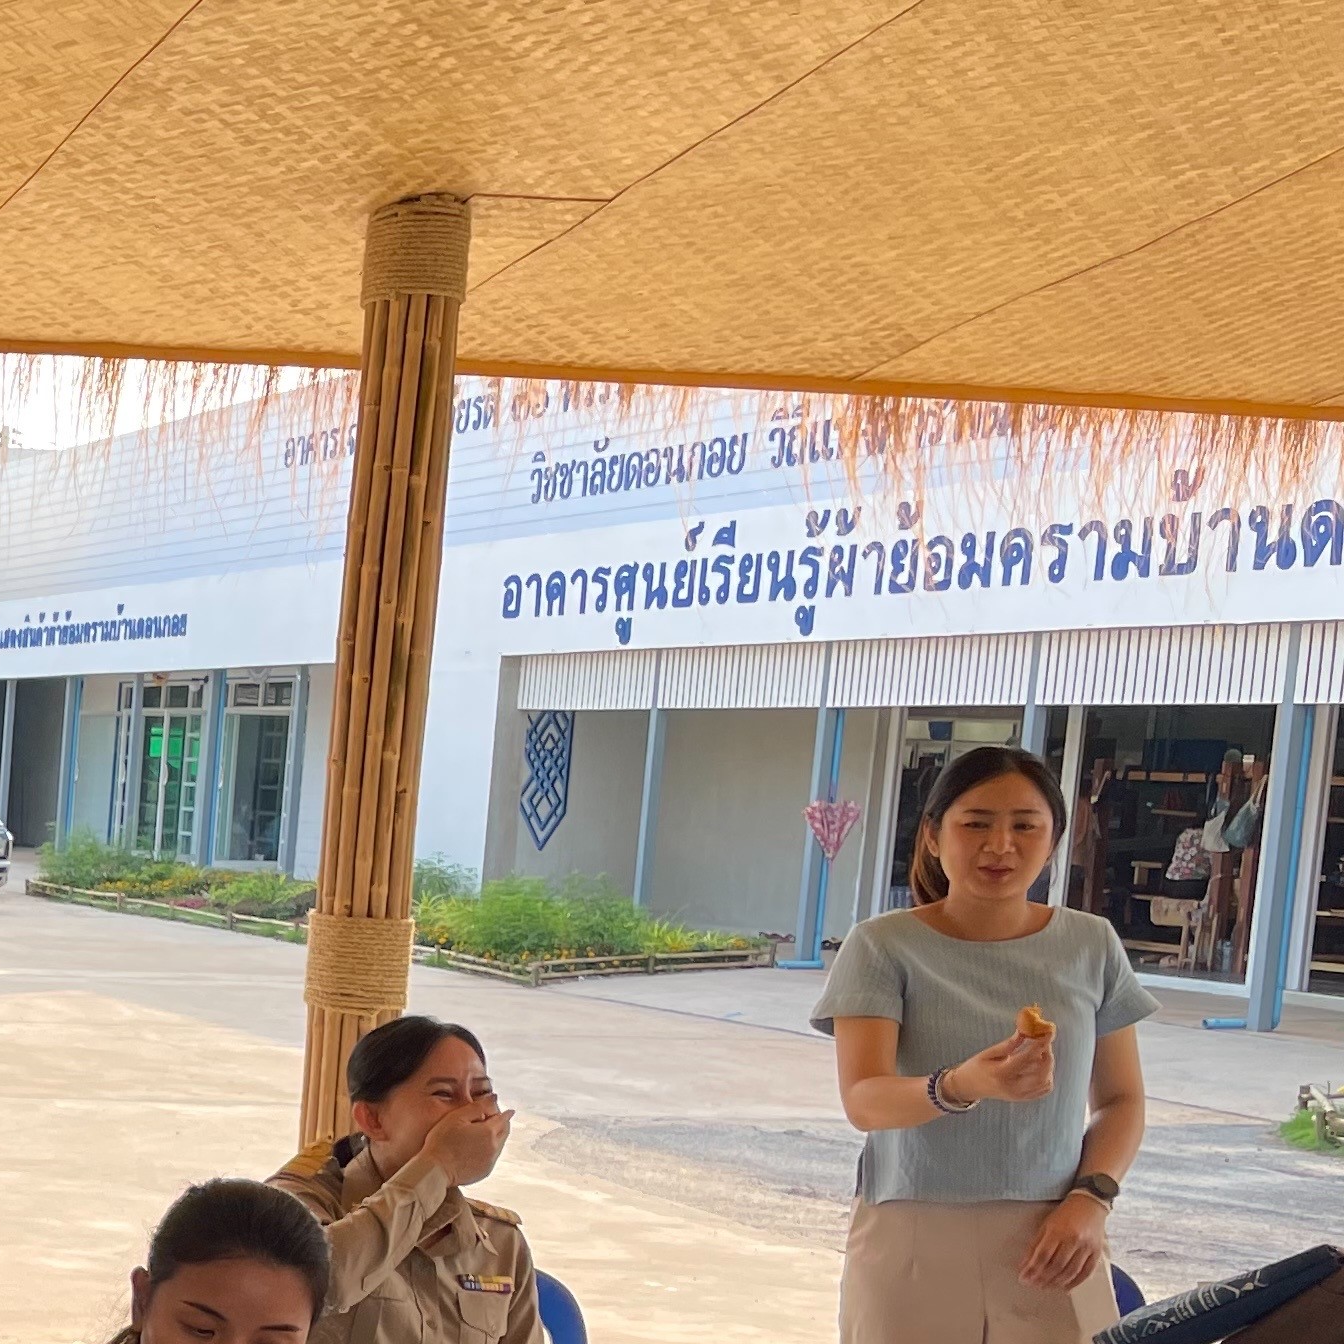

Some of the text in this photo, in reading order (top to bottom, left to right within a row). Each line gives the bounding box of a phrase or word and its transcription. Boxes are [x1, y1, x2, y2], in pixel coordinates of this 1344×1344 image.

[529, 432, 749, 505] วิชชาลัยดอนกอย
